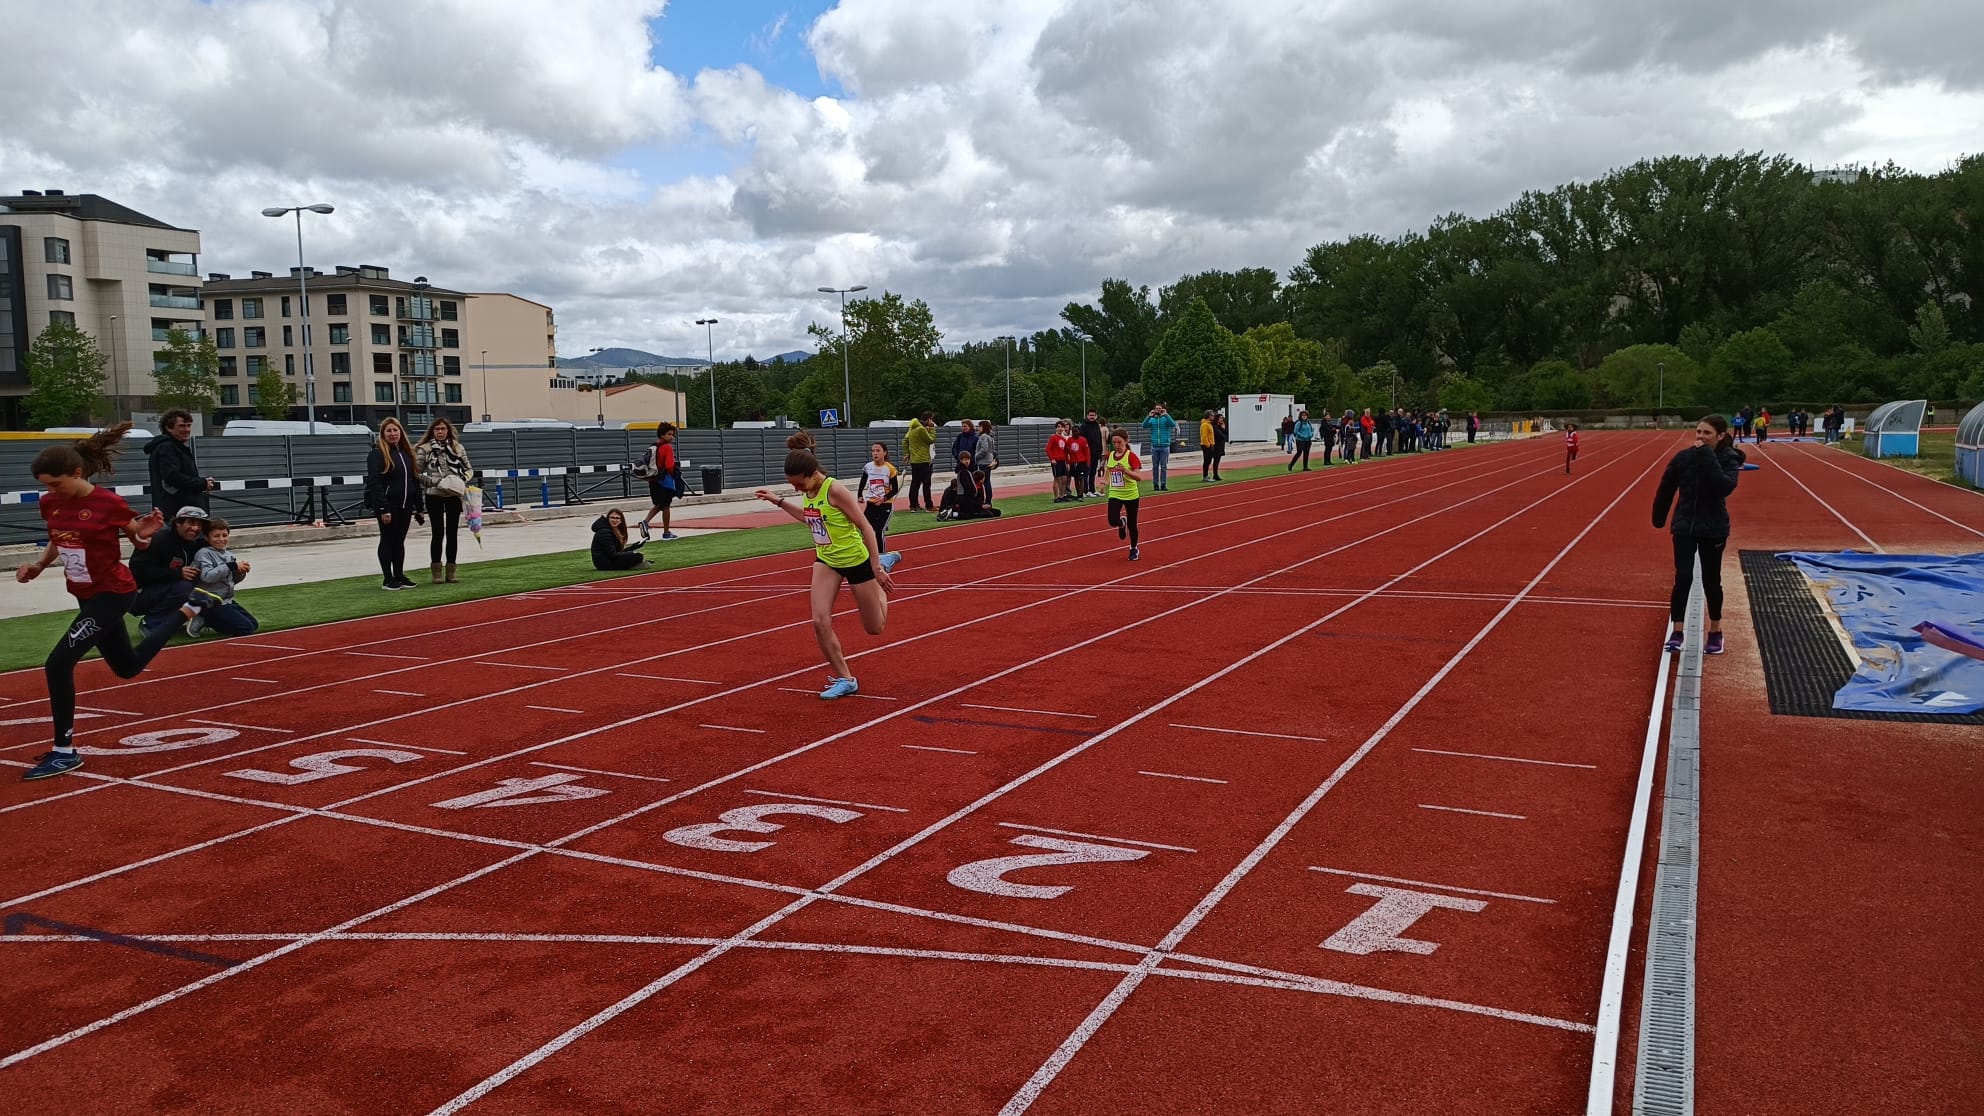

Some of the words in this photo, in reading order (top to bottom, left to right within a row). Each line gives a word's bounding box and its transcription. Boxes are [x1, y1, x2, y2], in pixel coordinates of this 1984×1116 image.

[68, 617, 102, 648] AIR
[222, 748, 425, 786] 5
[428, 772, 612, 810] 4
[662, 803, 865, 853] 3
[946, 834, 1152, 899] 2
[1318, 882, 1488, 956] 1
